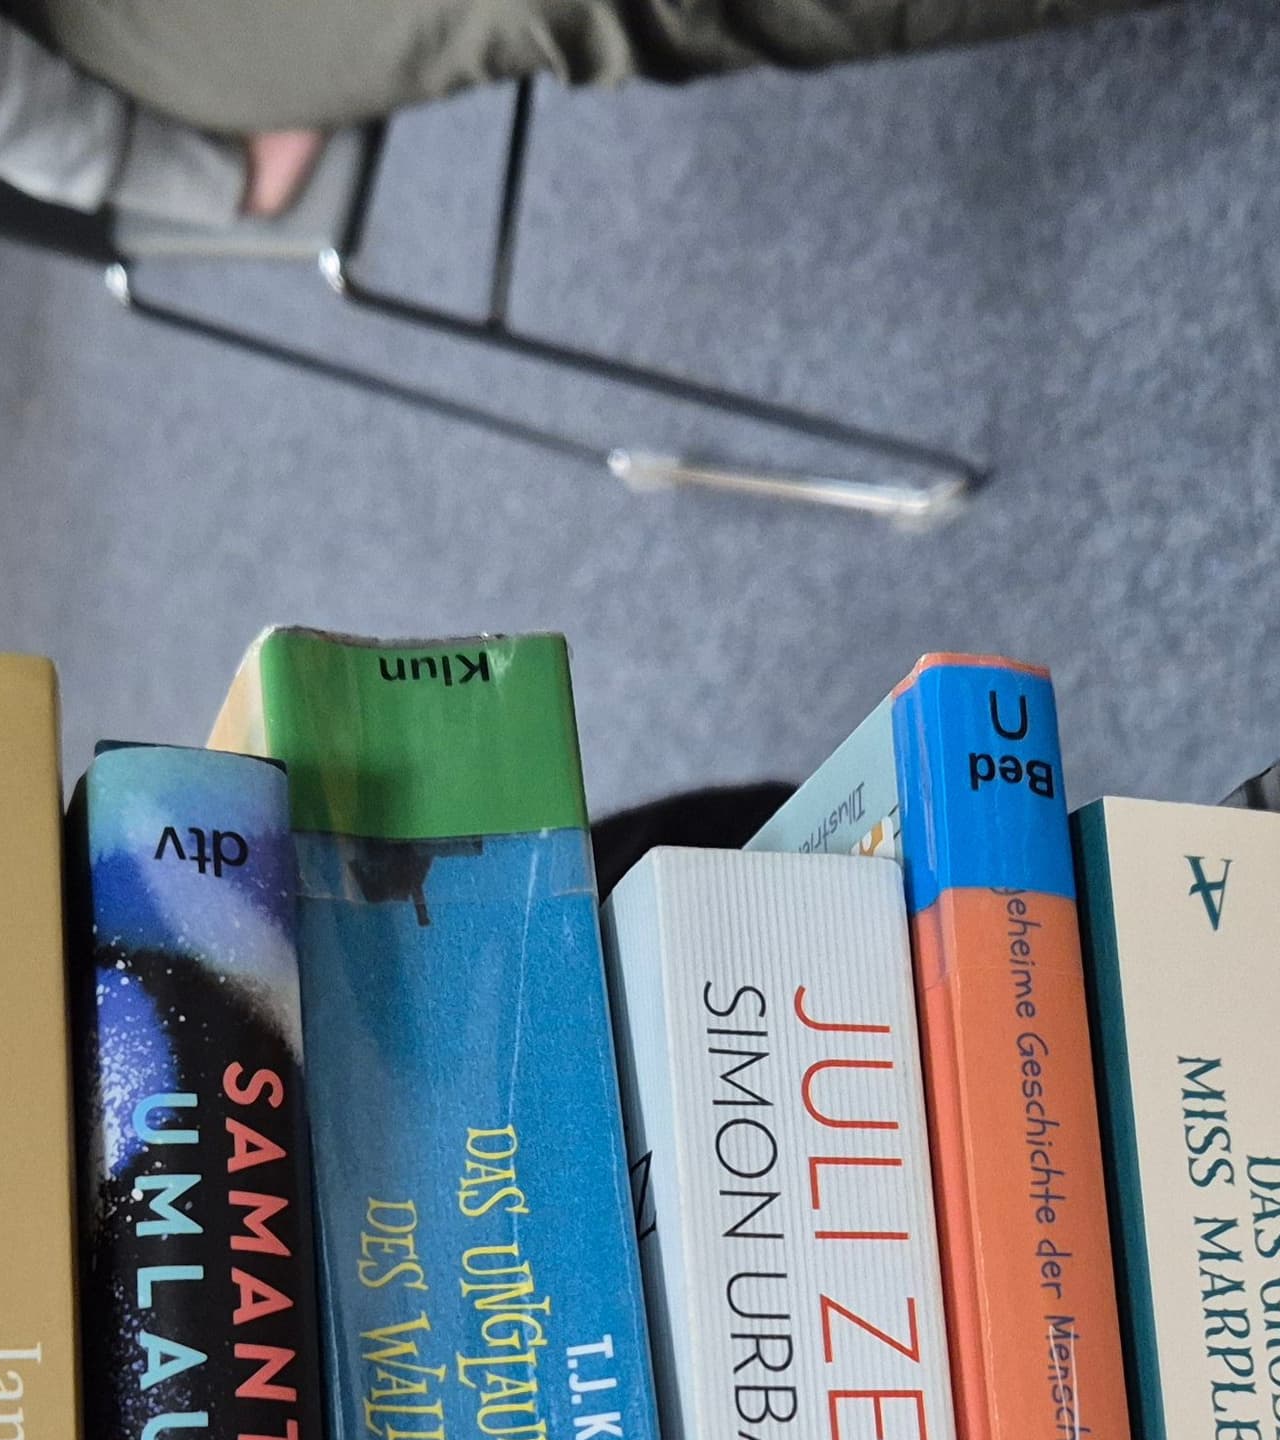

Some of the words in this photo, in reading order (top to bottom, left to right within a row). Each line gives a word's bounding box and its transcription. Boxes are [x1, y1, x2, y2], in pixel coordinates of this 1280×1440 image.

[378, 651, 491, 687] Klun
[969, 752, 1055, 800] Bed
[154, 824, 249, 878] dtv
[702, 979, 786, 1241] SIMON
[793, 984, 910, 1241] JULI
[1015, 1030, 1057, 1227] Geschichte
[1175, 1054, 1237, 1190] MISS
[458, 1124, 530, 1217] DAS
[357, 1196, 428, 1291] DES
[1034, 1236, 1075, 1300] der
[565, 1333, 615, 1406] T.J.
